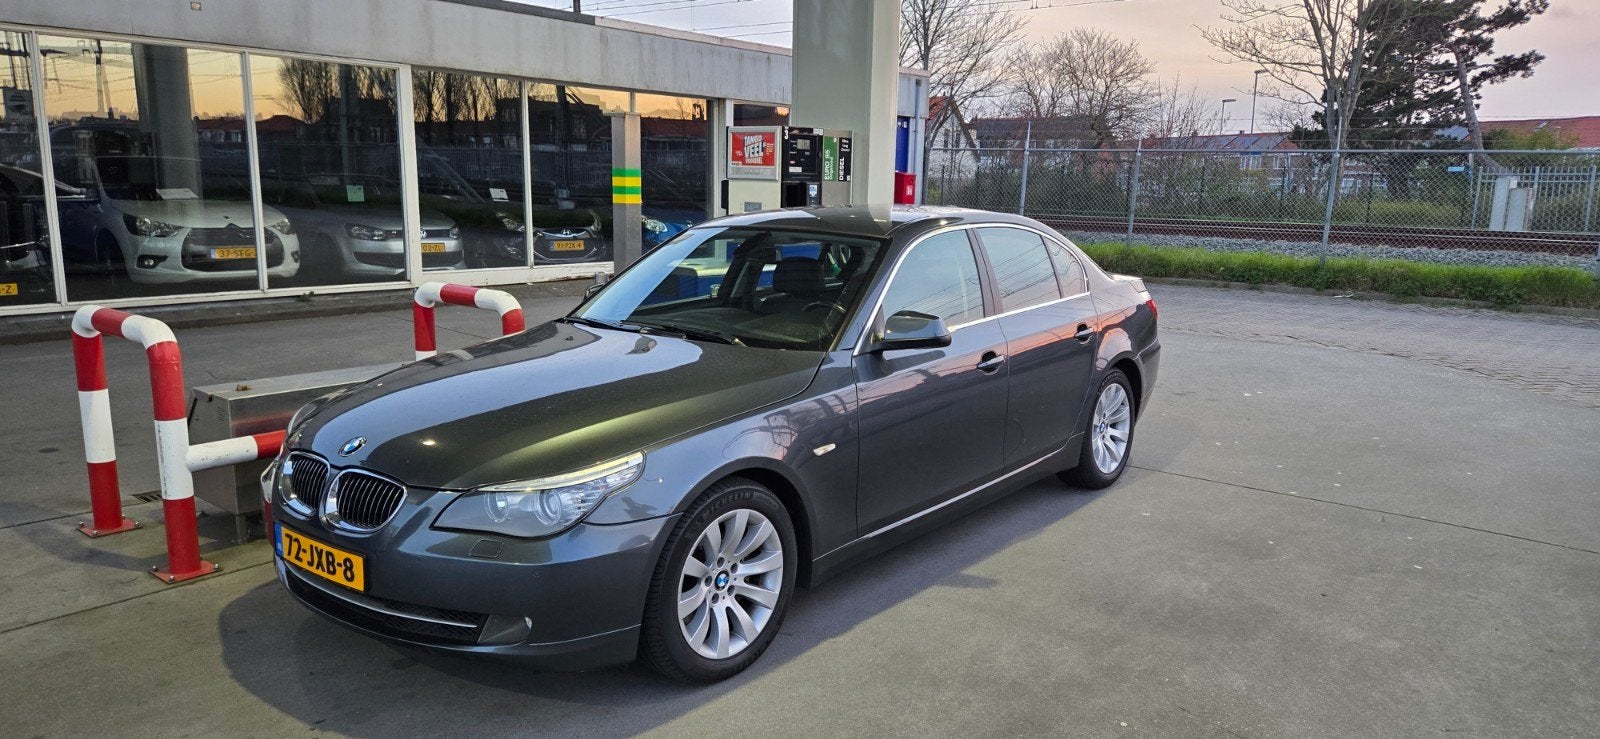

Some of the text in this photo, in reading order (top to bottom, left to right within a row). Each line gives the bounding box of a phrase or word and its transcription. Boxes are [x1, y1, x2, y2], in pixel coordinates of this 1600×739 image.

[744, 134, 763, 146] TANGO
[744, 142, 764, 158] VEEL
[219, 249, 254, 258] 37-SFG-
[702, 492, 752, 520] MICHELIN
[284, 532, 355, 583] 72-JXB-8
